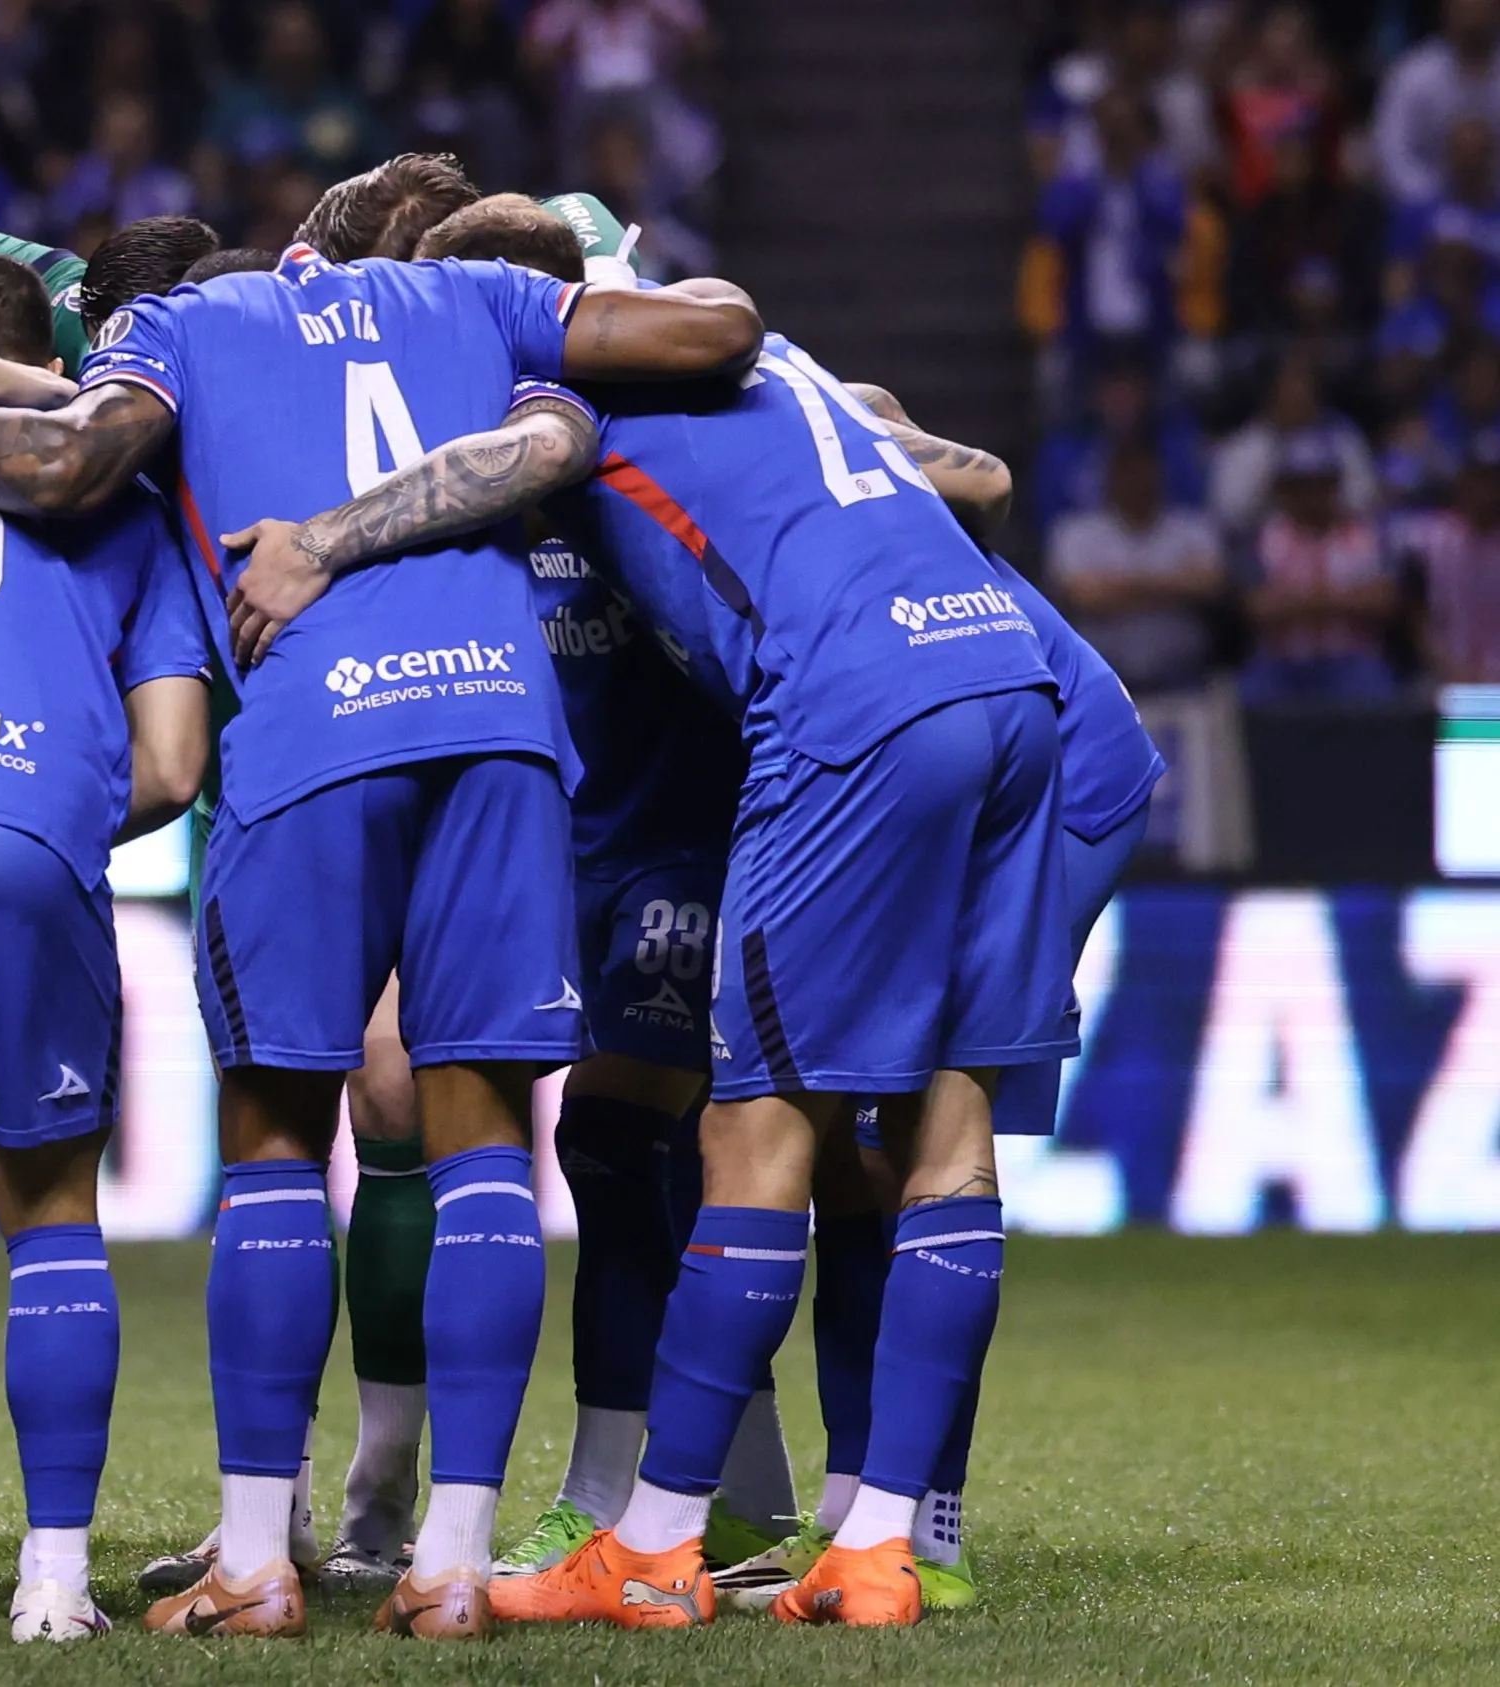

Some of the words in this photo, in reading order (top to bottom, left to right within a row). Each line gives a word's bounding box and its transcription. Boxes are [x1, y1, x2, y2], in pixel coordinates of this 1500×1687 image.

[552, 195, 602, 249] PIRMA
[296, 299, 381, 345] DITTA
[345, 361, 426, 499] 4
[529, 552, 580, 578] CRUZ
[925, 583, 1021, 621] cemix
[375, 640, 511, 682] cemix
[332, 685, 433, 719] ADHESIVOS
[436, 683, 449, 696] Y
[453, 680, 526, 696] ESTUCOS
[633, 899, 711, 981] 33
[238, 1238, 304, 1250] CRUZ
[435, 1233, 485, 1246] CRUZ
[489, 1234, 541, 1247] AZUL
[915, 1249, 973, 1275] CRUZ
